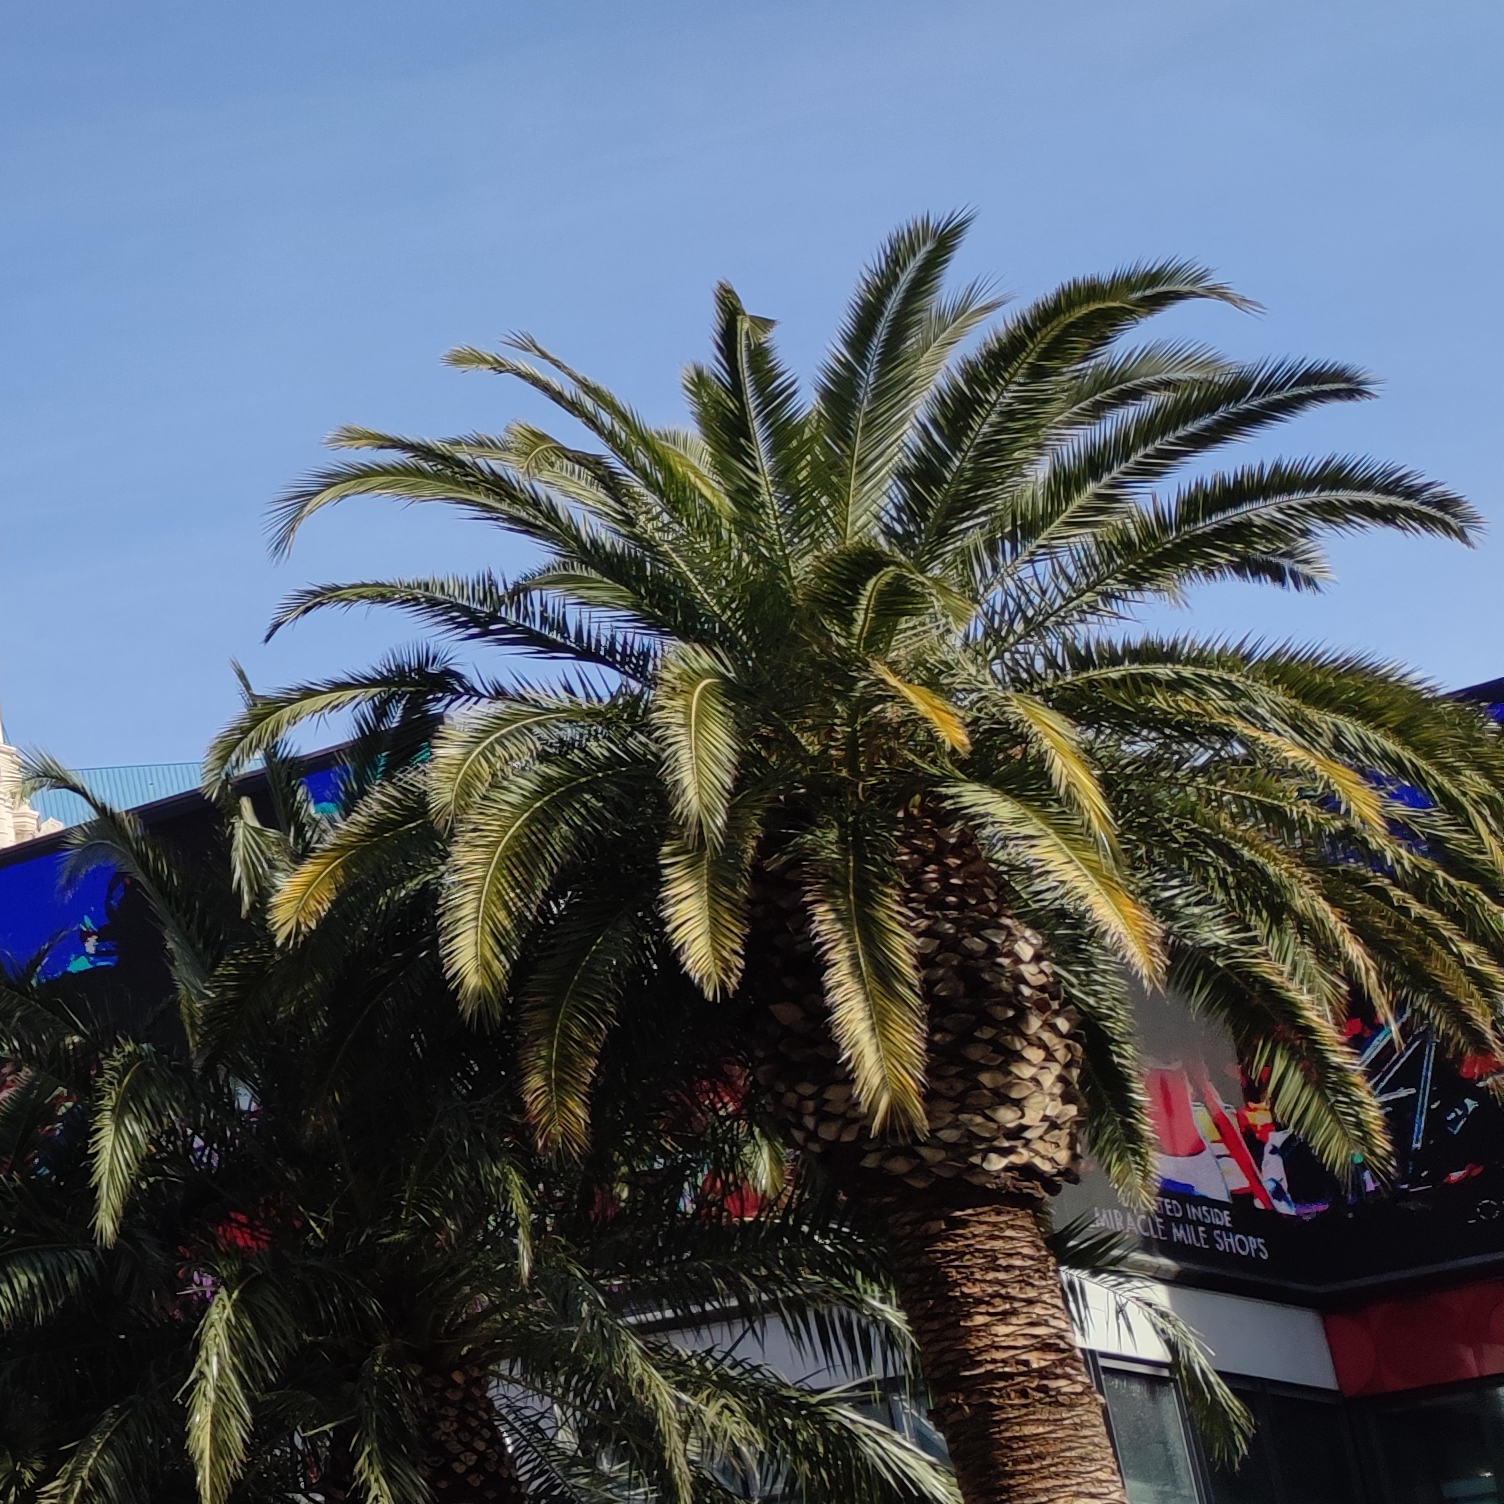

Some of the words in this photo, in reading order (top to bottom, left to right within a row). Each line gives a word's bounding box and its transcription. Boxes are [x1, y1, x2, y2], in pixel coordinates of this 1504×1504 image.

[1090, 1207, 1168, 1241] MIRACLE
[1172, 1221, 1210, 1249] MILE
[1213, 1229, 1270, 1260] SHOPS
[1186, 1202, 1234, 1228] INSIDE
